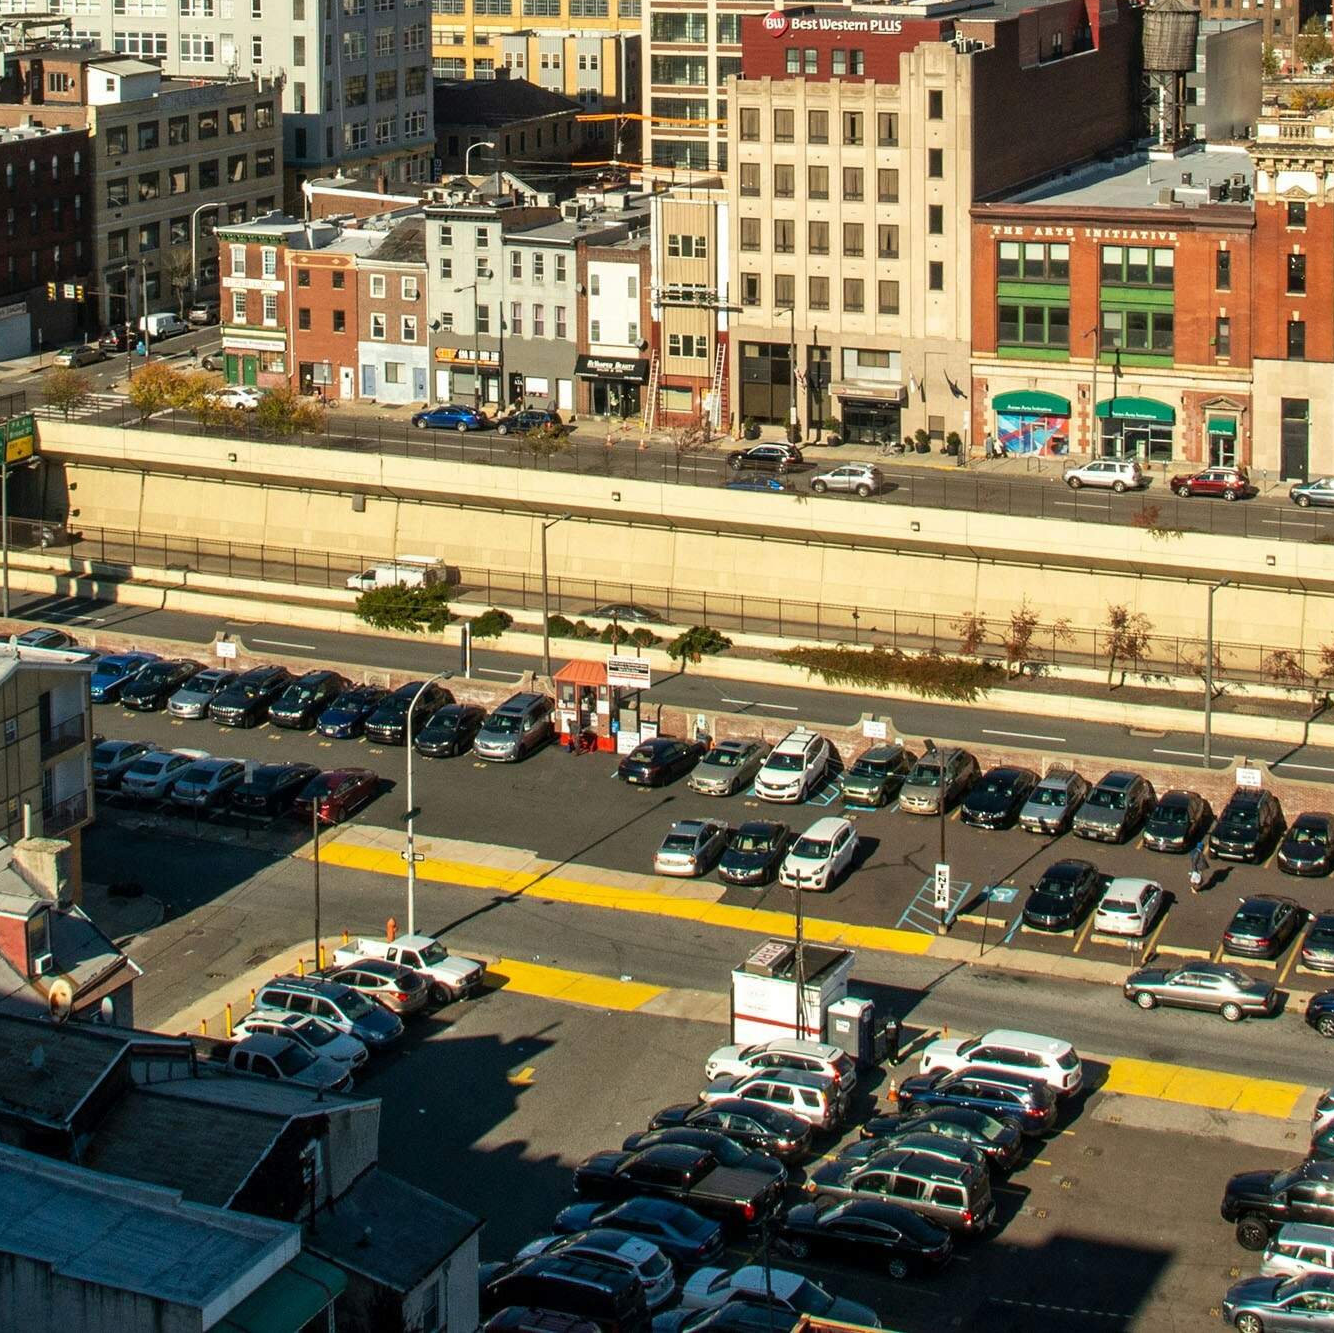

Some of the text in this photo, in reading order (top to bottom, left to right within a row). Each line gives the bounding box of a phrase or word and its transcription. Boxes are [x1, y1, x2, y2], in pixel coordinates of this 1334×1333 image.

[767, 17, 785, 29] BW
[791, 18, 902, 32] Best Western PLUS
[992, 226, 1178, 241] THE ARTS INITIATIVE
[938, 870, 947, 902] ENTER
[753, 943, 783, 964] PARK
